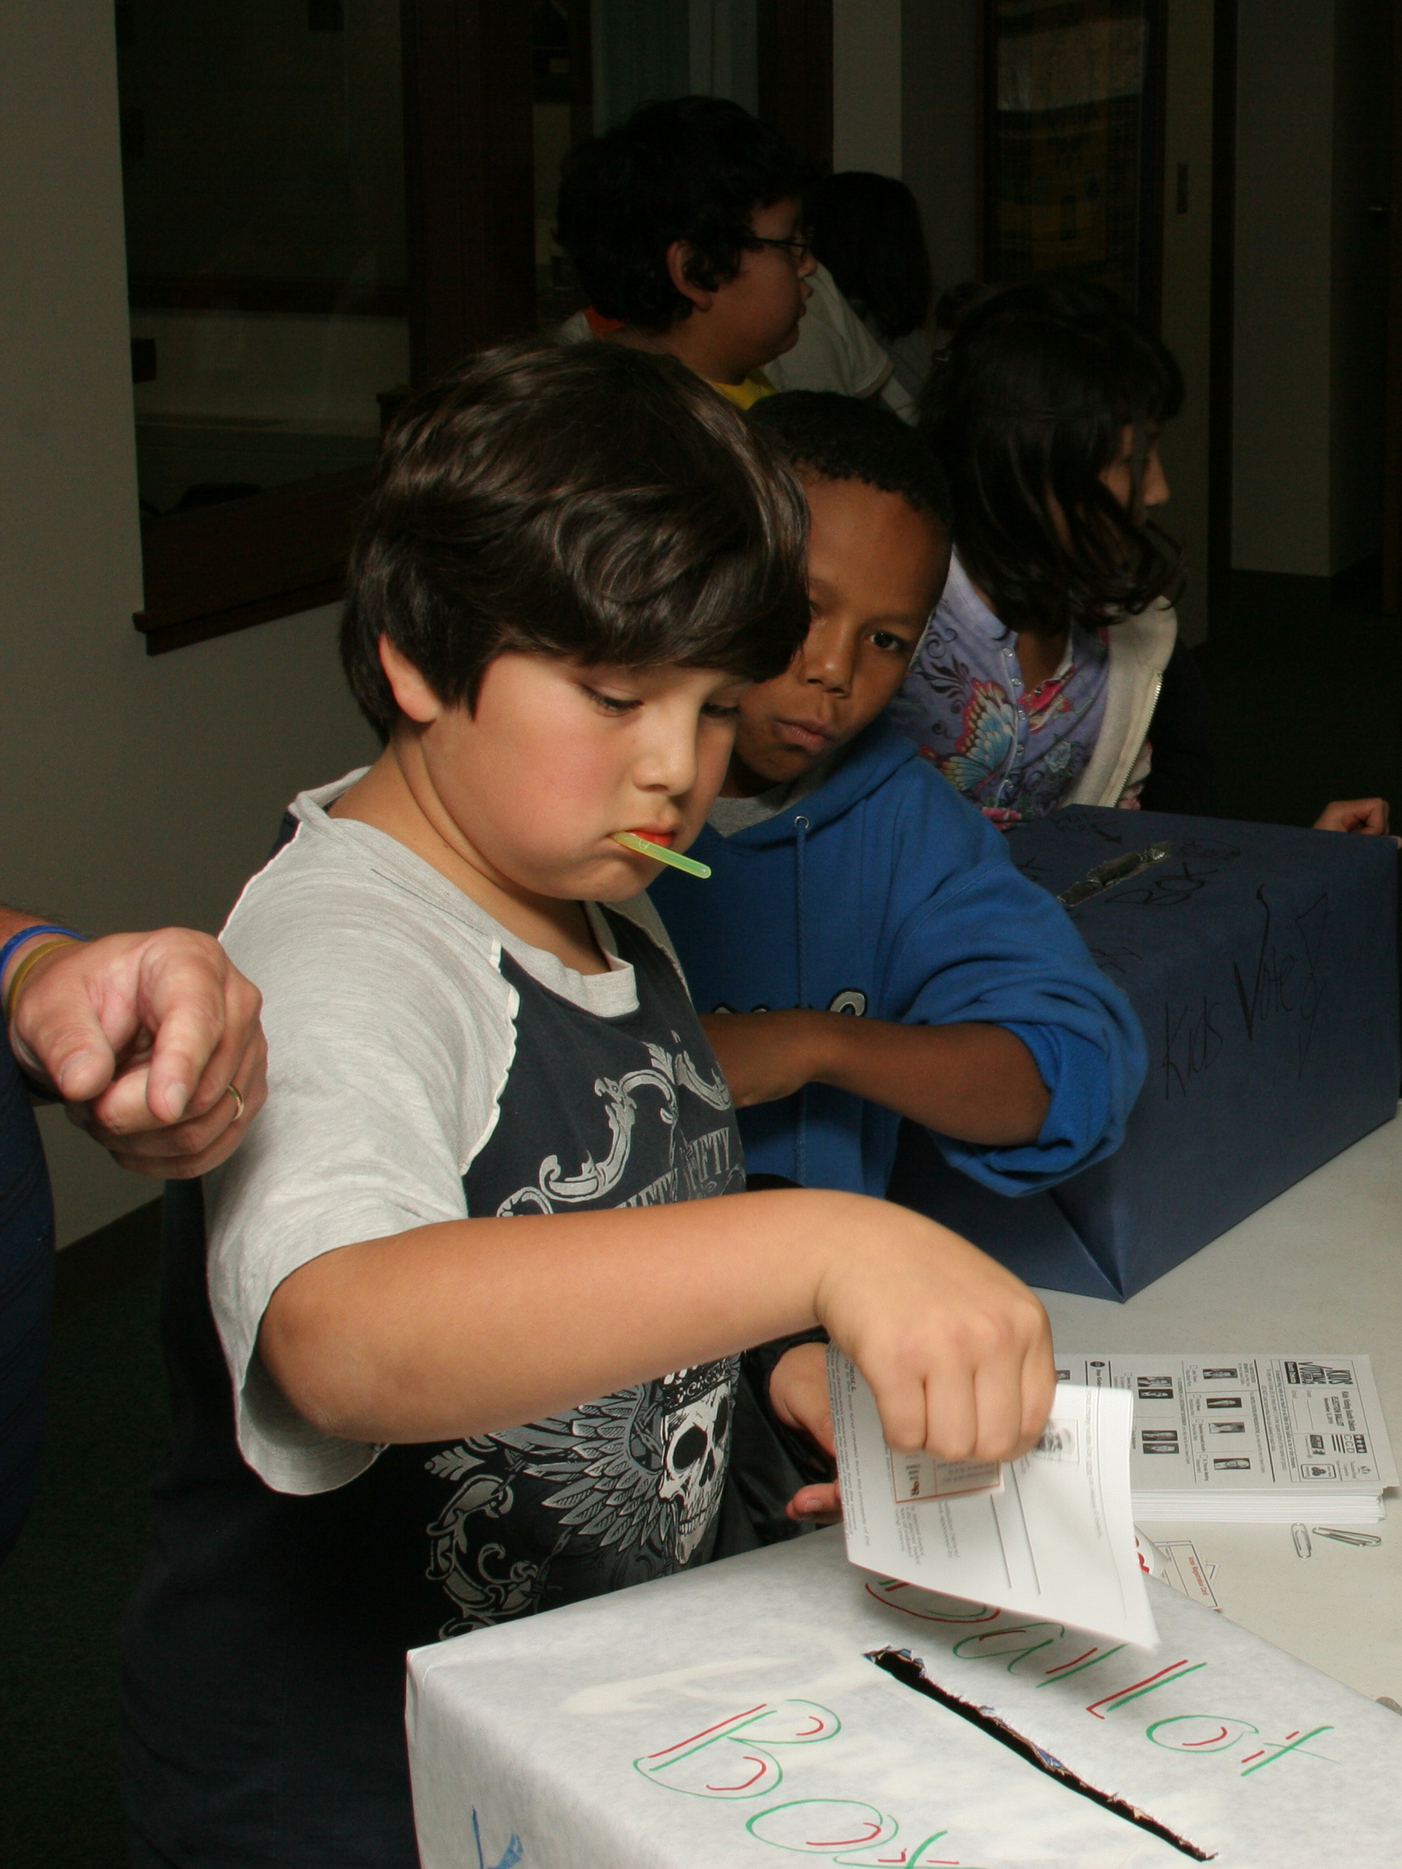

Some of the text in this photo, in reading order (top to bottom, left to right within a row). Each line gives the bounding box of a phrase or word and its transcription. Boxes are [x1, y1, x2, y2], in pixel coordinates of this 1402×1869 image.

[1161, 995, 1224, 1101] Kids
[1192, 1566, 1204, 1587] Registration
[1200, 1586, 1209, 1596] Card
